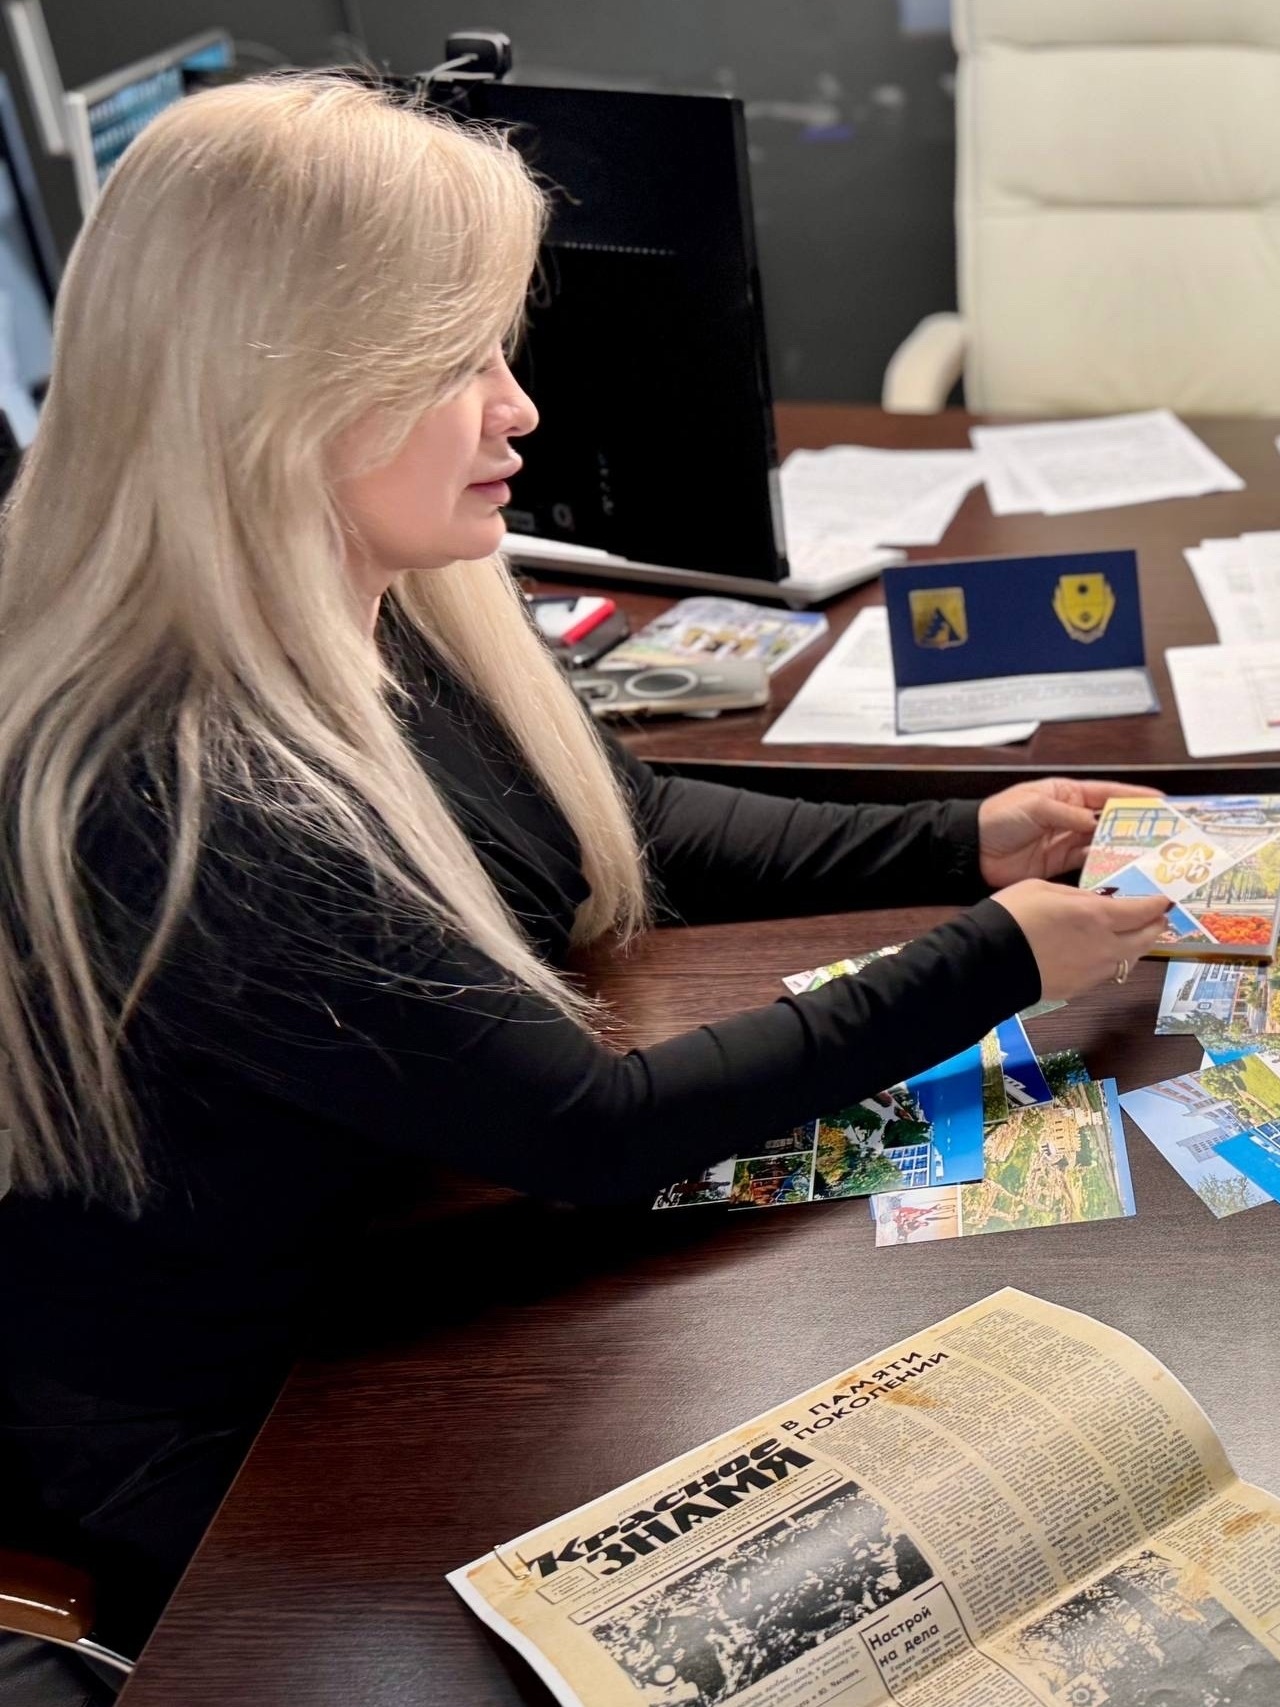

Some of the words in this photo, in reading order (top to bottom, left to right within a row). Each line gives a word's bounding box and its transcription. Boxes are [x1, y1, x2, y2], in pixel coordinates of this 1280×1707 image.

[780, 1420, 799, 1431] В
[808, 1352, 923, 1416] ПАМЯТИ
[793, 1352, 951, 1440] ПОКОЛЕНИЙ
[587, 1446, 815, 1576] ЗНАМЯ
[868, 1606, 932, 1650] Настрой
[879, 1650, 898, 1667] на
[904, 1624, 940, 1653] дела
